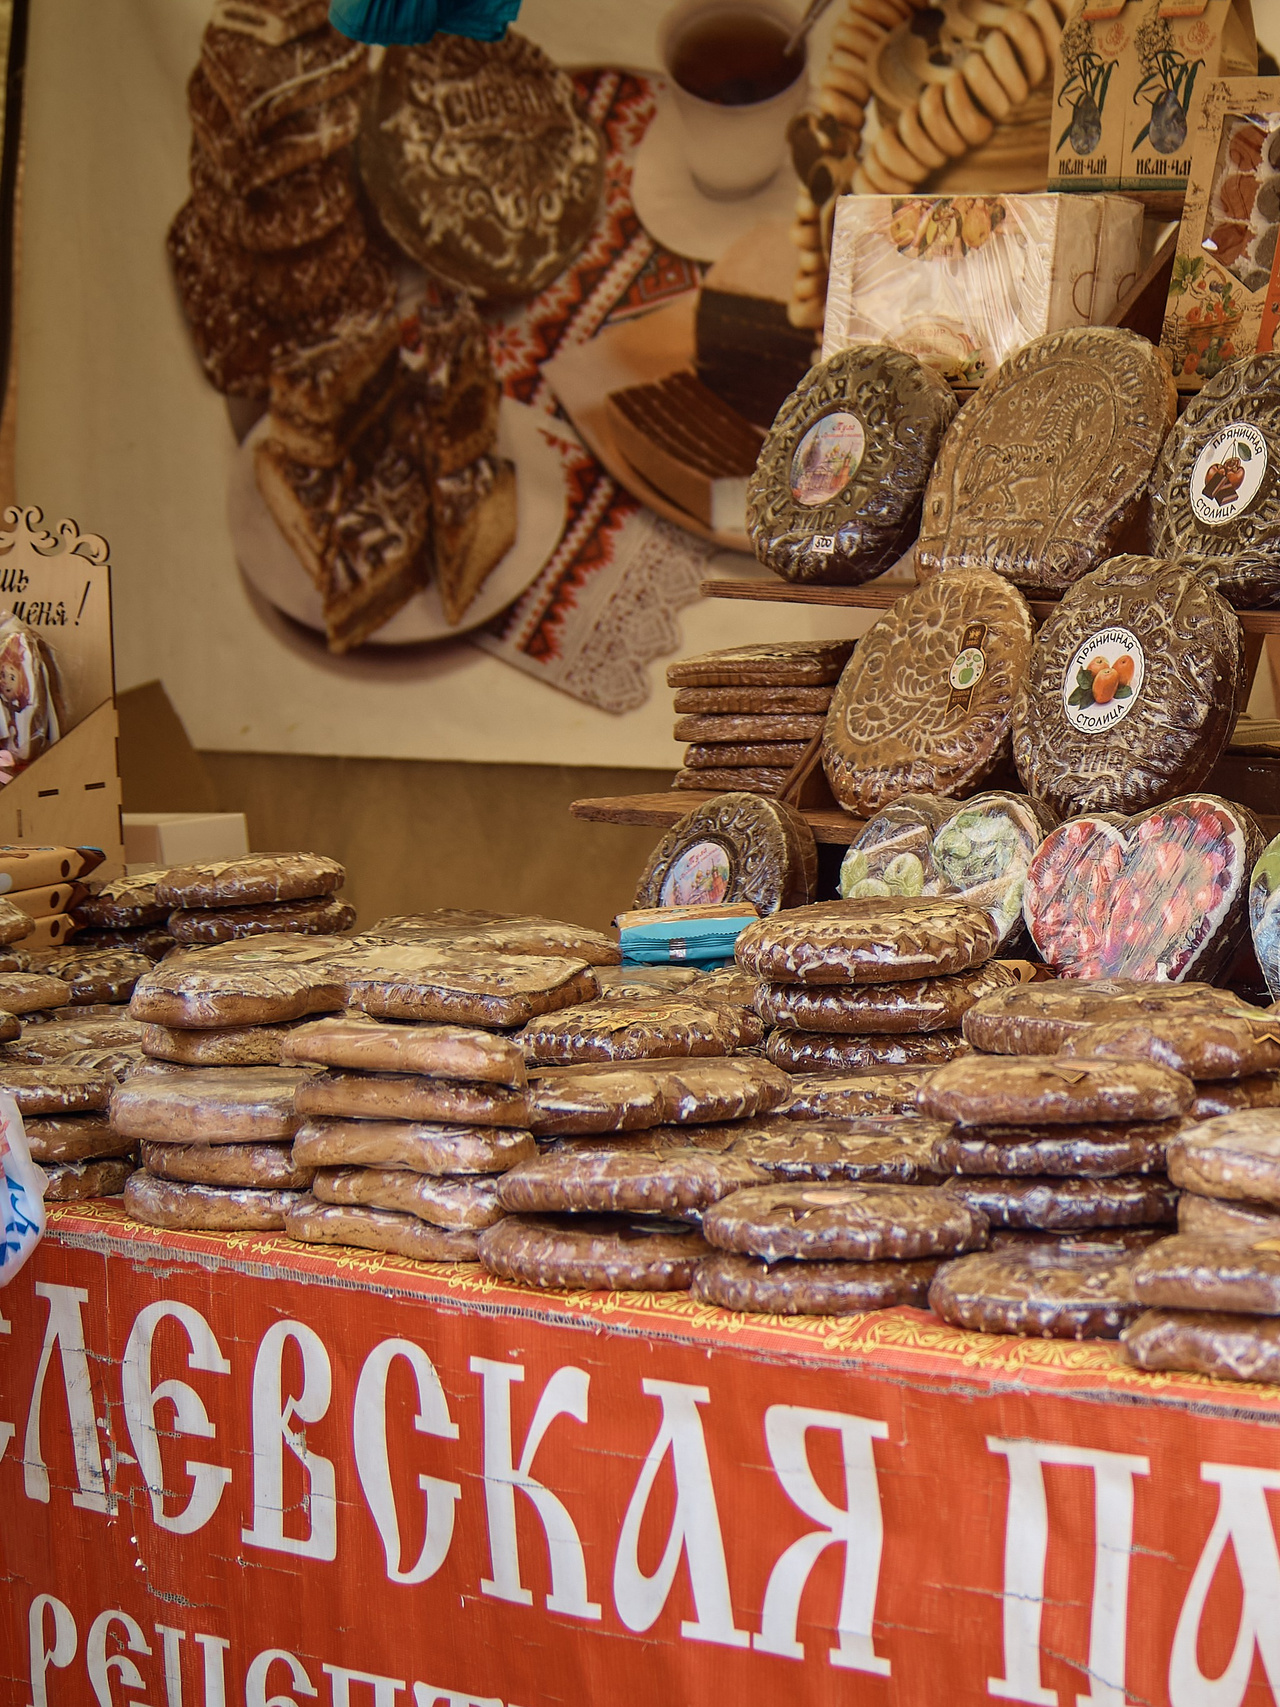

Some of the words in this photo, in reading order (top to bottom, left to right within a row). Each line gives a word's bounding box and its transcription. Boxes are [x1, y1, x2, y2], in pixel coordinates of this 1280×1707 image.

[1212, 428, 1263, 455] ПРЯНИЧНАЯ
[1196, 498, 1236, 519] СТОЛИЦА
[1076, 632, 1134, 665] ПРЯНИЧНАЯ
[1076, 704, 1124, 727] СТОЛИЦА
[0, 1280, 892, 1677] ЛЕВСКАЯ
